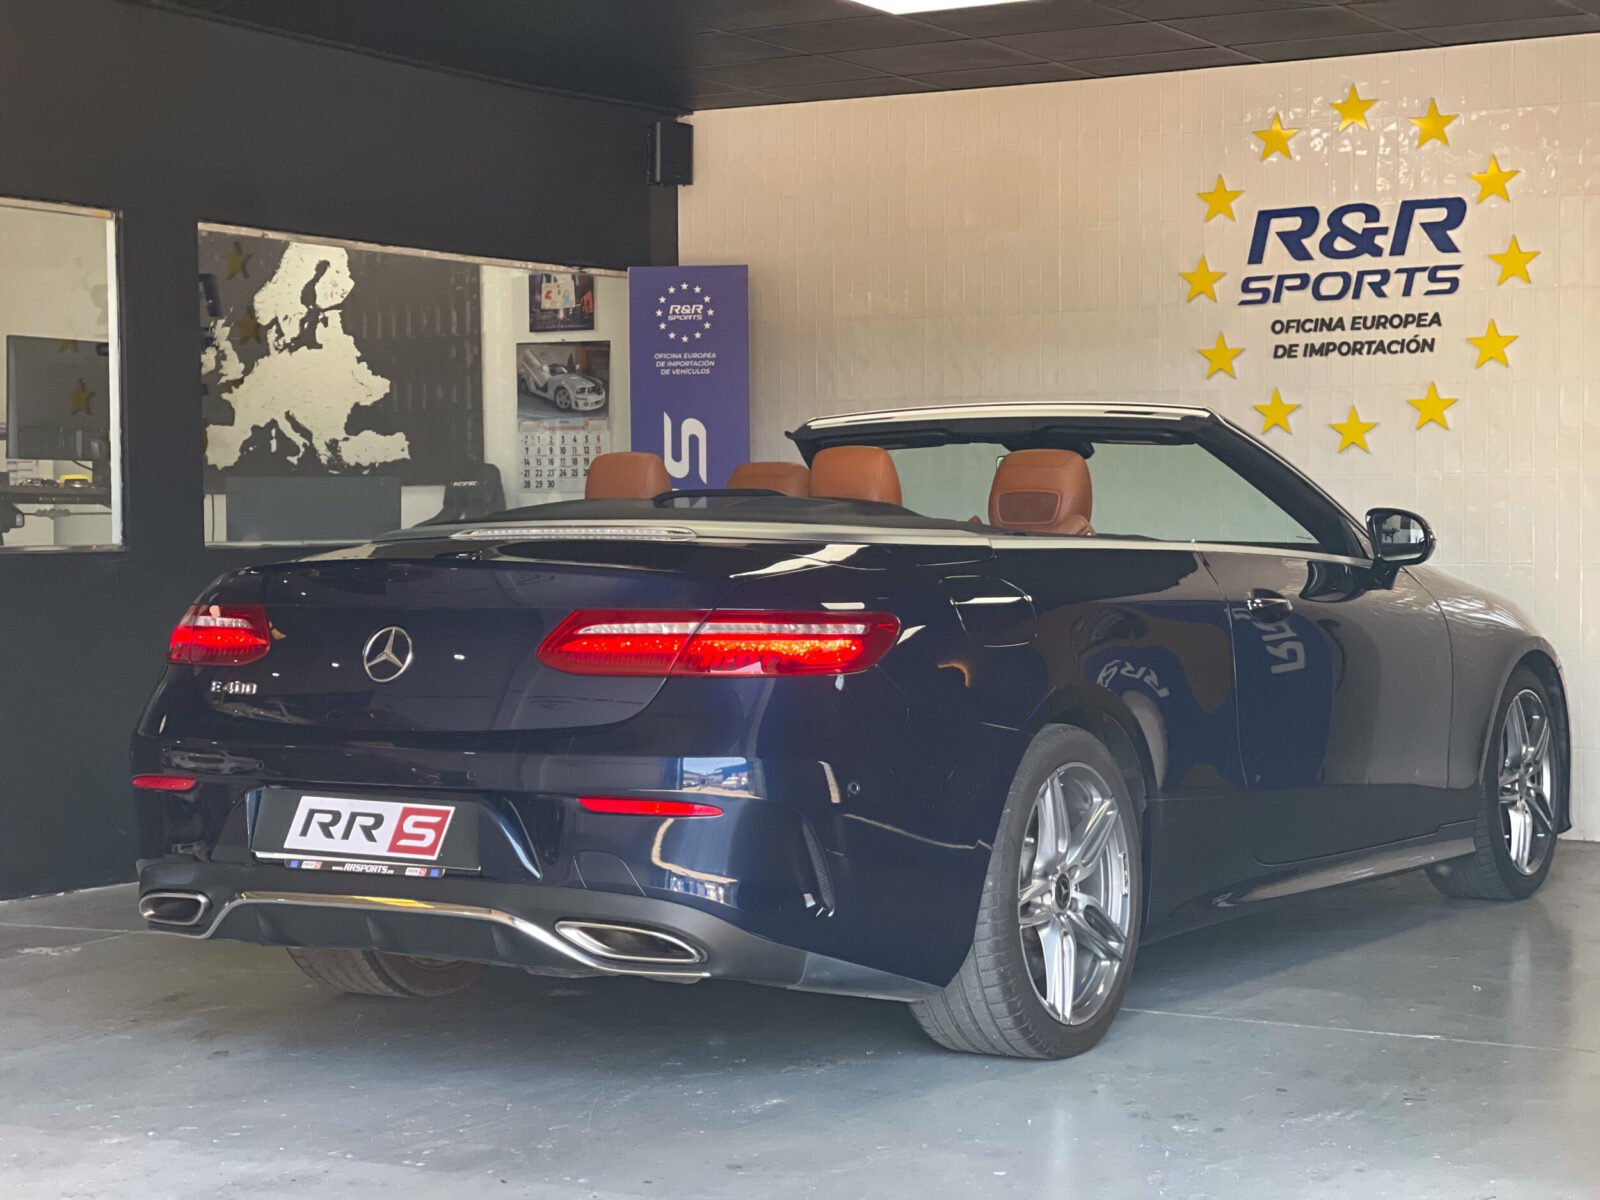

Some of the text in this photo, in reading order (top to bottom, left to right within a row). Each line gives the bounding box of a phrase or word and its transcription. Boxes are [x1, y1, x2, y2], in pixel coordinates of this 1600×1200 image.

[1247, 196, 1467, 265] R&R
[1237, 263, 1465, 306] SPORTS
[669, 304, 704, 315] R&R
[1270, 311, 1443, 335] OFICINA EUROPEA
[1272, 335, 1436, 360] DE IMPORTACIÓN
[523, 458, 530, 466] 14
[559, 469, 567, 477] 24
[571, 468, 578, 477] 25
[547, 480, 555, 488] 30
